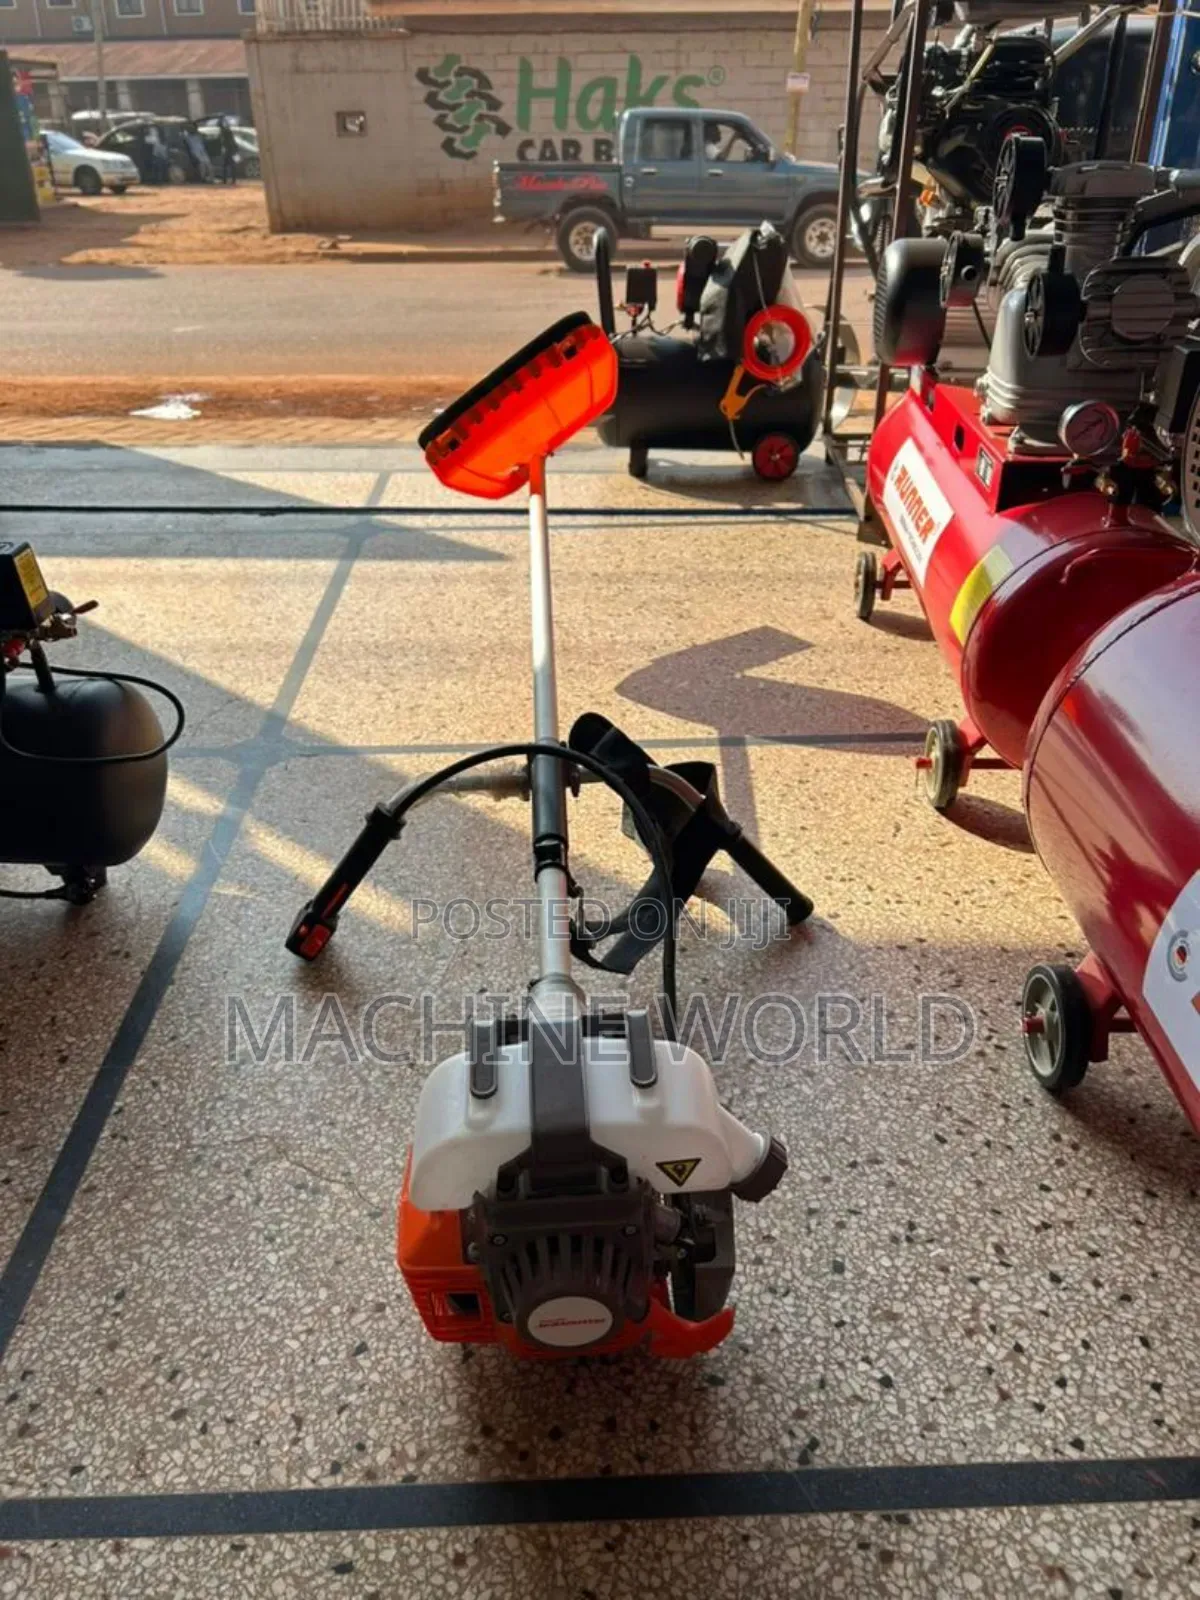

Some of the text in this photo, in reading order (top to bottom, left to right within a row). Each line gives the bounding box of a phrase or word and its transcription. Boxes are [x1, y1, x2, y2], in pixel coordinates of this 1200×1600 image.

[515, 54, 706, 133] Haks
[516, 138, 584, 162] CAR
[894, 464, 936, 545] RUNNER
